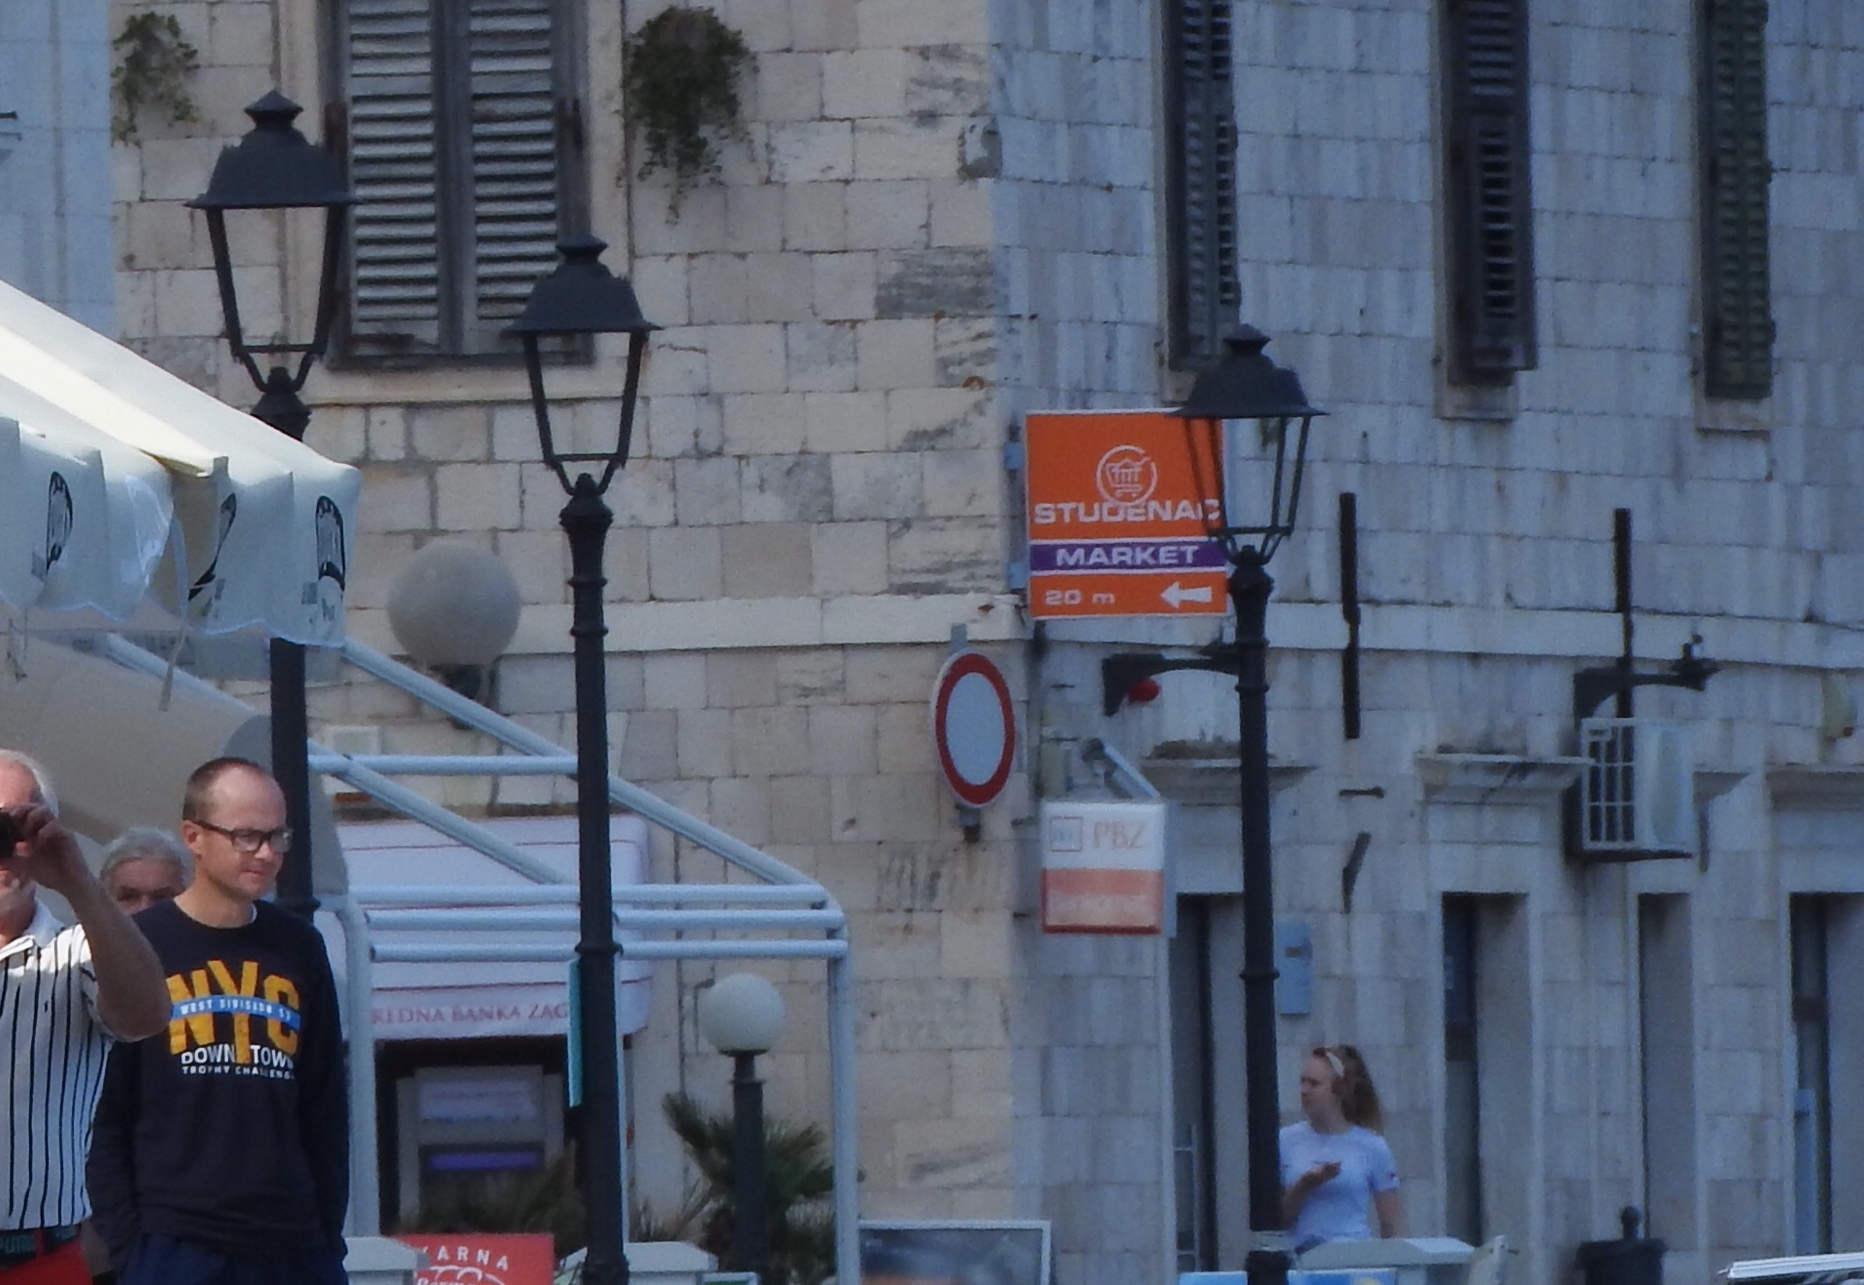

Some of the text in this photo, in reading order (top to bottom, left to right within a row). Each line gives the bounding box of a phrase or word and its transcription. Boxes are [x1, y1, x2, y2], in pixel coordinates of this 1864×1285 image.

[1034, 498, 1222, 525] STUDENAC
[1055, 545, 1200, 567] MARKET
[1044, 589, 1116, 606] 20 m
[165, 958, 300, 1065] NYC
[528, 1002, 569, 1021] ZAG
[180, 1043, 237, 1065] DOWN
[422, 1245, 509, 1272] ARNA
